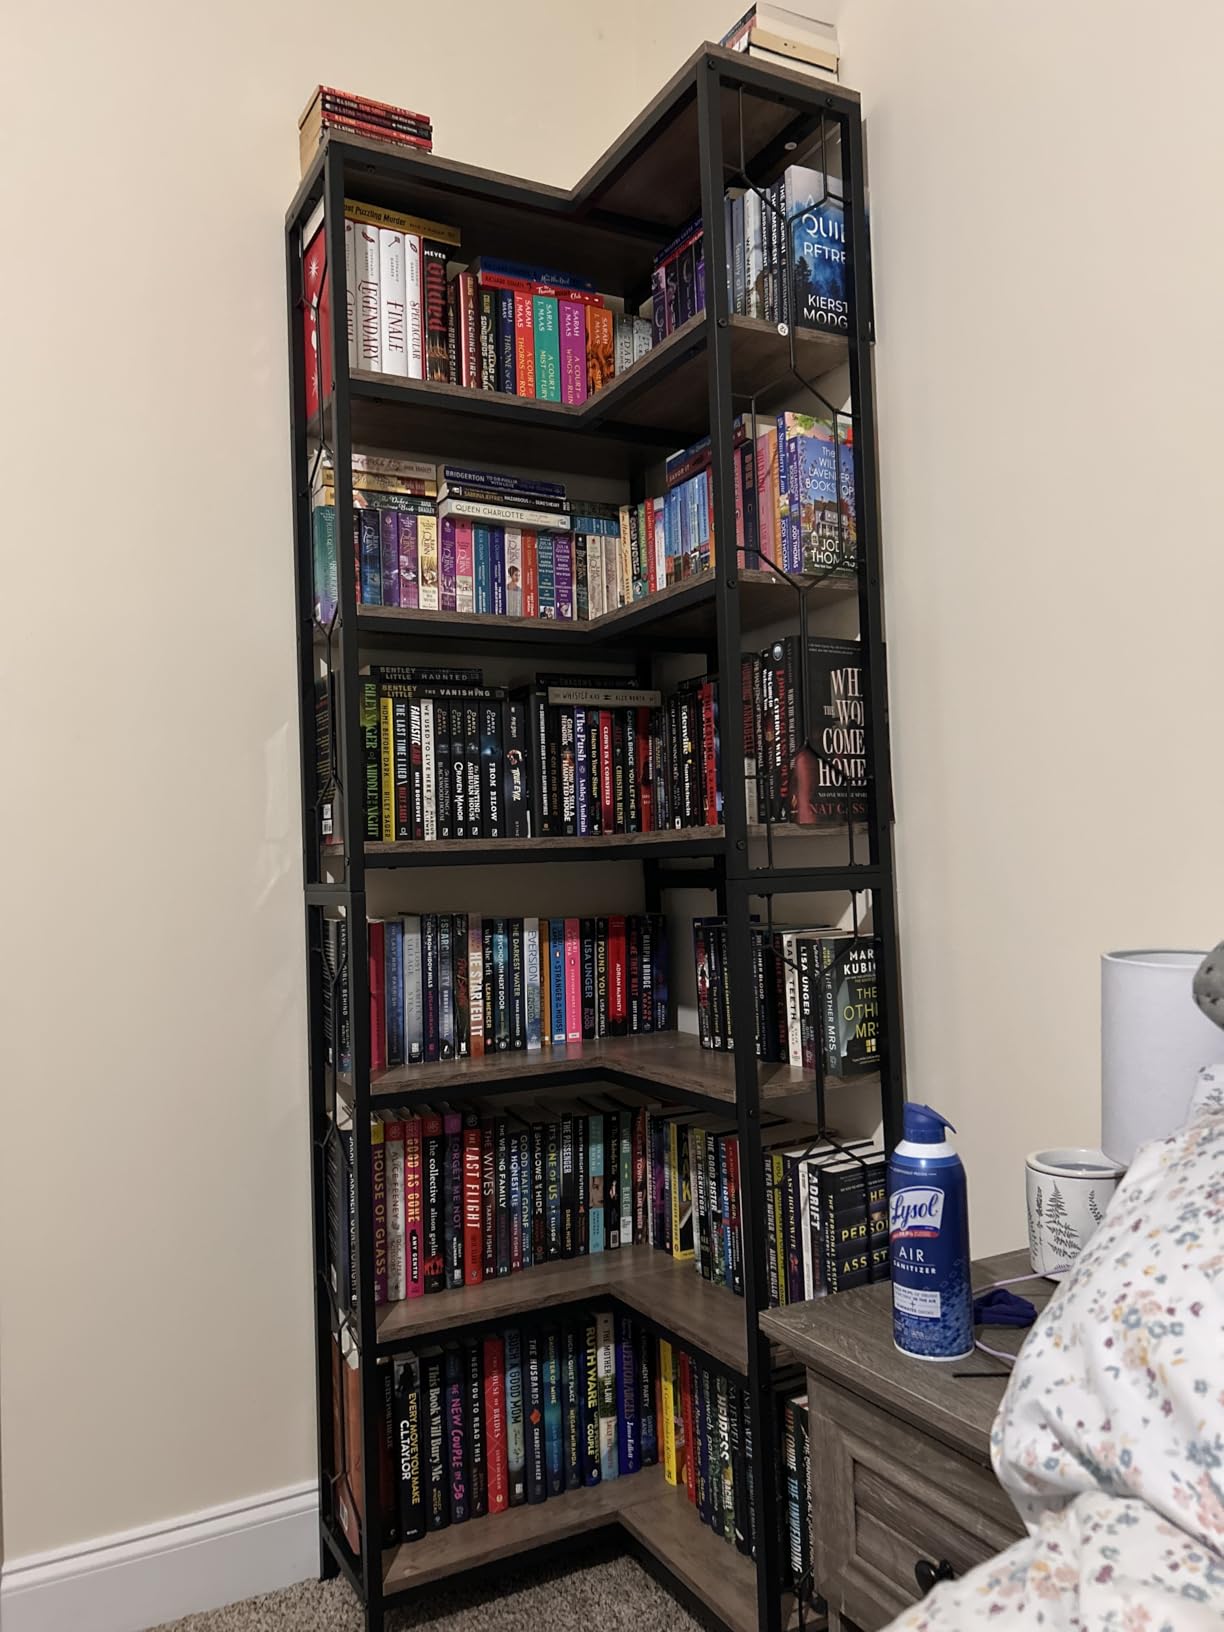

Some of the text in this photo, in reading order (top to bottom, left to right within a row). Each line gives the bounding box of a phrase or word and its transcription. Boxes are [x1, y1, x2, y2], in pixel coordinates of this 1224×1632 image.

[424, 250, 446, 260] MEYER
[427, 261, 447, 333] Gilded
[358, 280, 379, 364] LEGENDARY
[387, 300, 404, 353] FINALE
[410, 300, 421, 360] SPECTACULAR
[538, 309, 546, 332] MAAS
[565, 315, 573, 337] MAAS
[595, 322, 603, 345] MAAS
[504, 335, 512, 368] THRONE
[541, 379, 549, 400] FURY
[445, 469, 485, 483] BRIDGERTON
[455, 504, 524, 520] QUEEN CHARLOTTE
[425, 704, 430, 716] WE
[426, 741, 431, 752] TO
[822, 727, 866, 757] COME
[576, 712, 588, 833] The Push Ashley Audrain
[453, 762, 465, 821] CRAVEN MANOR
[489, 762, 498, 822] FROM BELOW
[563, 760, 572, 822] HAUNTED HOUSE
[528, 930, 539, 982] EVERSION
[584, 939, 593, 998] LISA UNGER
[598, 940, 606, 973] FOUND
[642, 934, 652, 989] HAIRPIN BRIDGE
[484, 928, 495, 1029] why she left LEAH MERCER
[554, 965, 562, 1001] STRANGER
[800, 945, 811, 1015] LISA UNGER
[857, 986, 879, 1001] THE
[470, 971, 483, 1022] STARTED
[789, 979, 799, 1021] TEETH
[471, 1025, 483, 1037] IT
[407, 1137, 420, 1169] GOOD
[408, 1173, 420, 1188] AS
[465, 1146, 481, 1229] LAST FLIGHT
[498, 1137, 507, 1208] WRONG FAMILY
[533, 1132, 544, 1215] SHADOWS HIDE
[707, 1135, 719, 1211] THE GOOD SISTER
[373, 1149, 387, 1275] HOUSE OF GLASS
[408, 1191, 421, 1223] GONE
[427, 1139, 440, 1257] the collective alison gaylin
[808, 1172, 821, 1231] ADRIFT
[891, 1193, 939, 1228] Lysol
[767, 1203, 776, 1232] MOTHER
[787, 1195, 798, 1250] HOUSEWIFE
[828, 1211, 836, 1258] PERSONAL
[769, 1248, 777, 1268] AIMEE
[893, 1259, 937, 1275] SANITIZER
[899, 1246, 925, 1263] AIR
[770, 1268, 779, 1300] MOLLOY
[529, 1339, 538, 1356] THE
[530, 1358, 539, 1405] HUSBANDS
[567, 1359, 575, 1380] QUIET
[584, 1326, 599, 1409] RUTH WARE
[473, 1402, 480, 1414] TO
[568, 1381, 576, 1403] PLACE
[428, 1364, 443, 1481] This Book Will Bury Me
[473, 1416, 481, 1439] READ
[493, 1407, 502, 1438] BRIDES
[702, 1370, 718, 1462] greenwich park
[409, 1392, 420, 1504] EVERY MOVE YOU MAKE
[473, 1442, 482, 1463] THIS
[587, 1422, 596, 1457] COUPLE
[785, 1432, 803, 1573] CONDIE THE UNWEDDING
